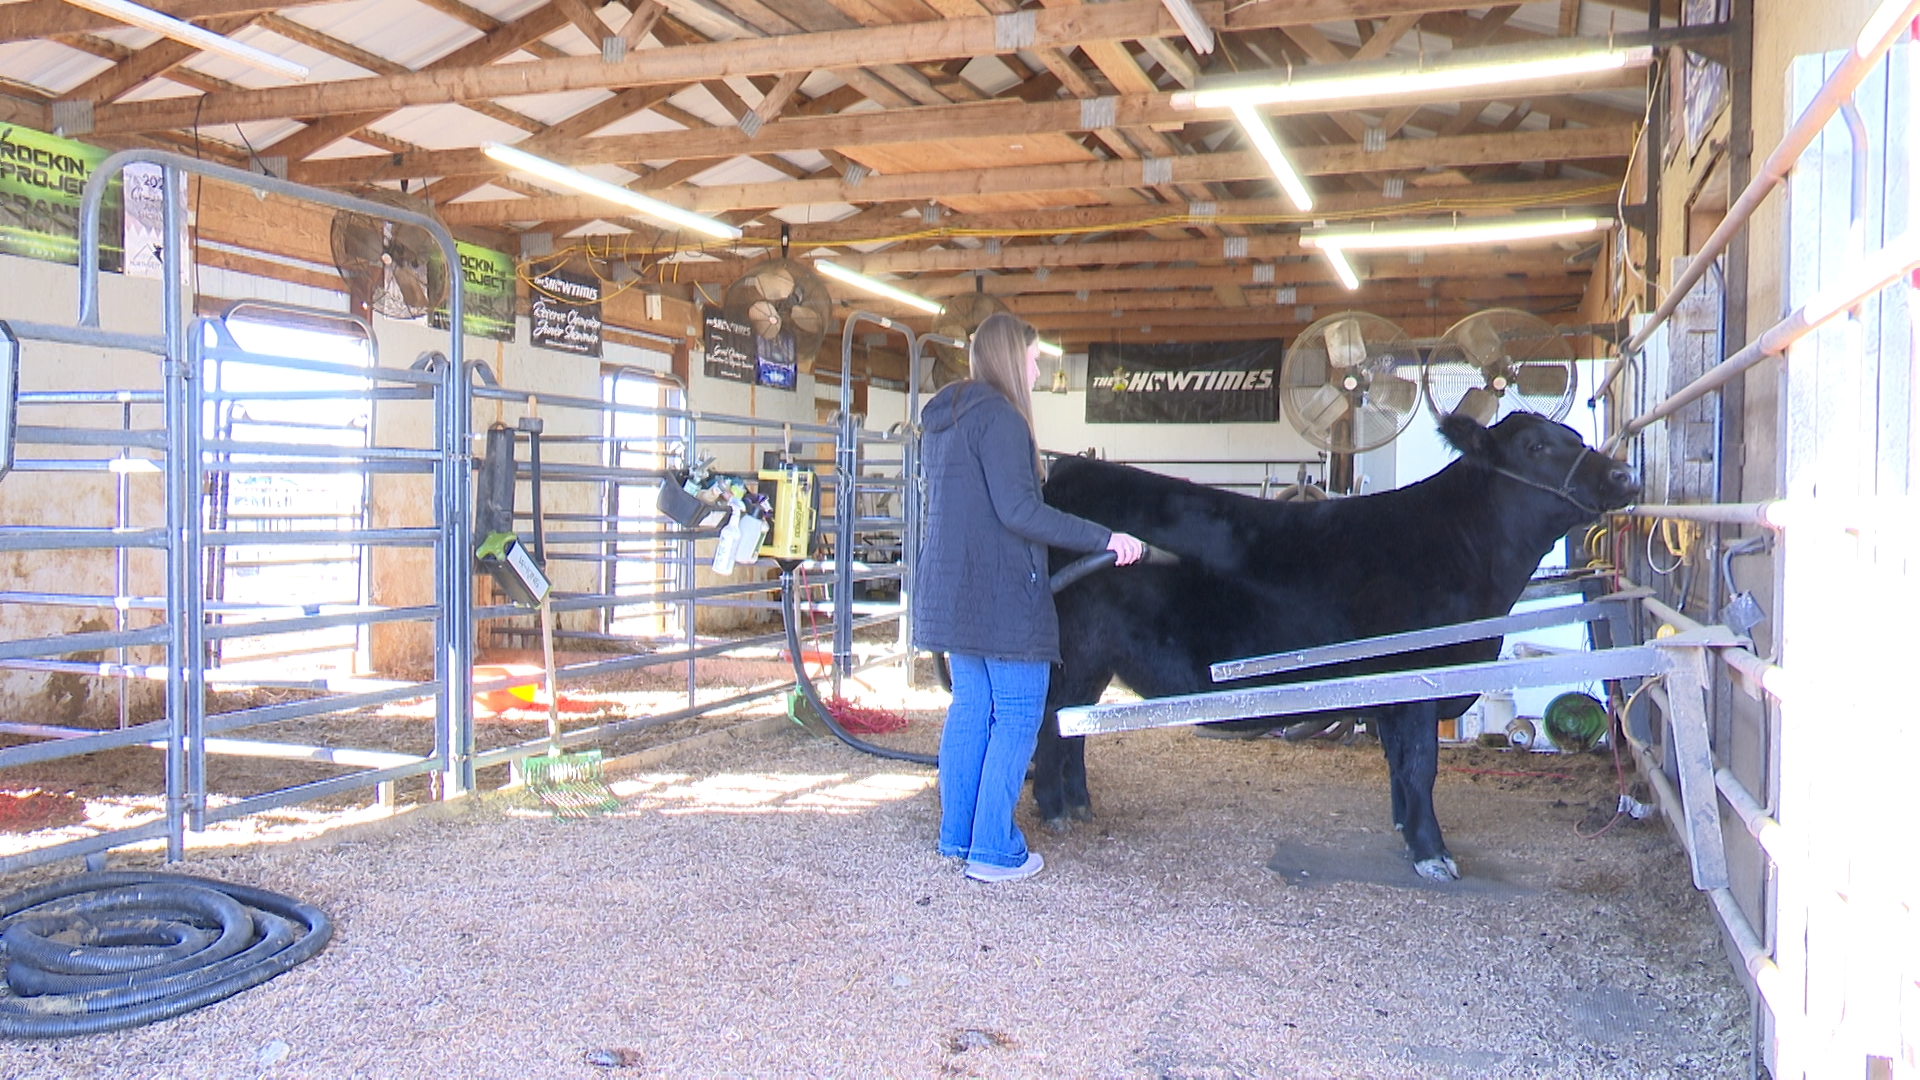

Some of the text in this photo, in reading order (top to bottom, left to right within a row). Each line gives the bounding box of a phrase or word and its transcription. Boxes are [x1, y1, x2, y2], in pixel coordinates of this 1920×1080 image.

[1, 141, 85, 176] ROCKIN
[1, 161, 87, 195] PROJE
[460, 254, 494, 274] OCKIN
[462, 269, 507, 290] ROJECT
[1093, 375, 1113, 389] THE
